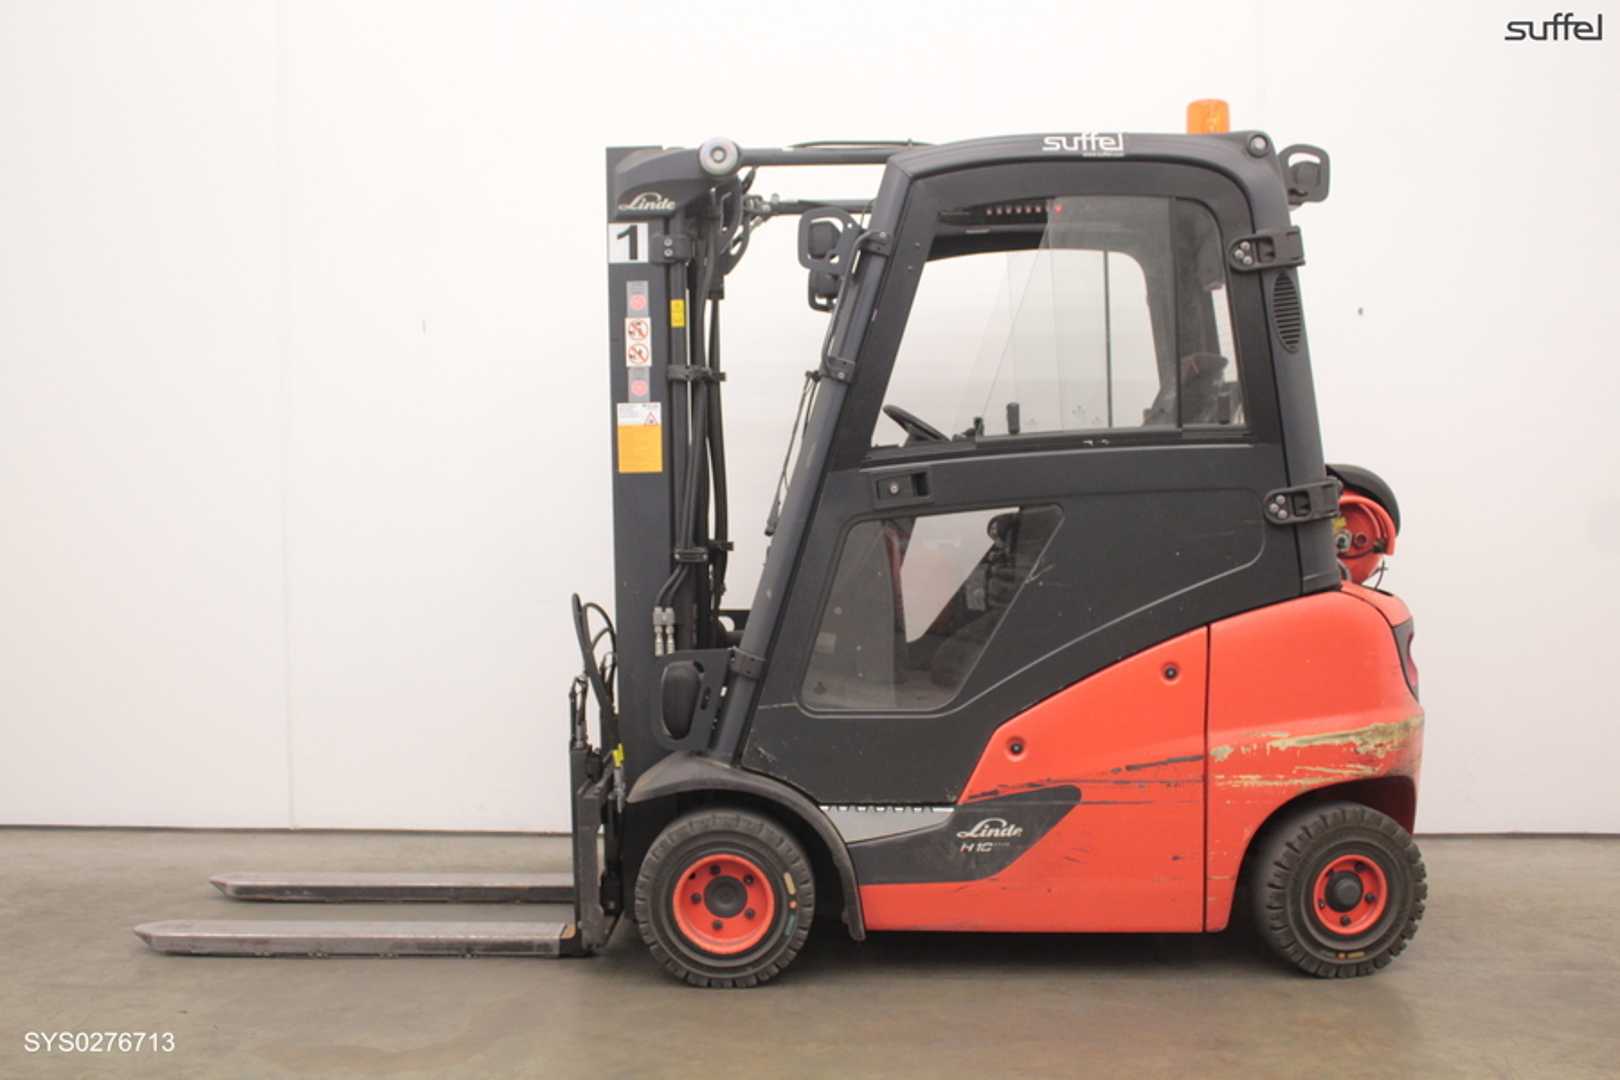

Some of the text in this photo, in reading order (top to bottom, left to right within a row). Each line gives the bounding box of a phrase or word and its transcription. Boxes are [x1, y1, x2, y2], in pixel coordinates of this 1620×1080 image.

[1042, 131, 1125, 151] suffel
[618, 191, 676, 211] Linde
[616, 224, 638, 260] 1
[956, 816, 1023, 838] Linde
